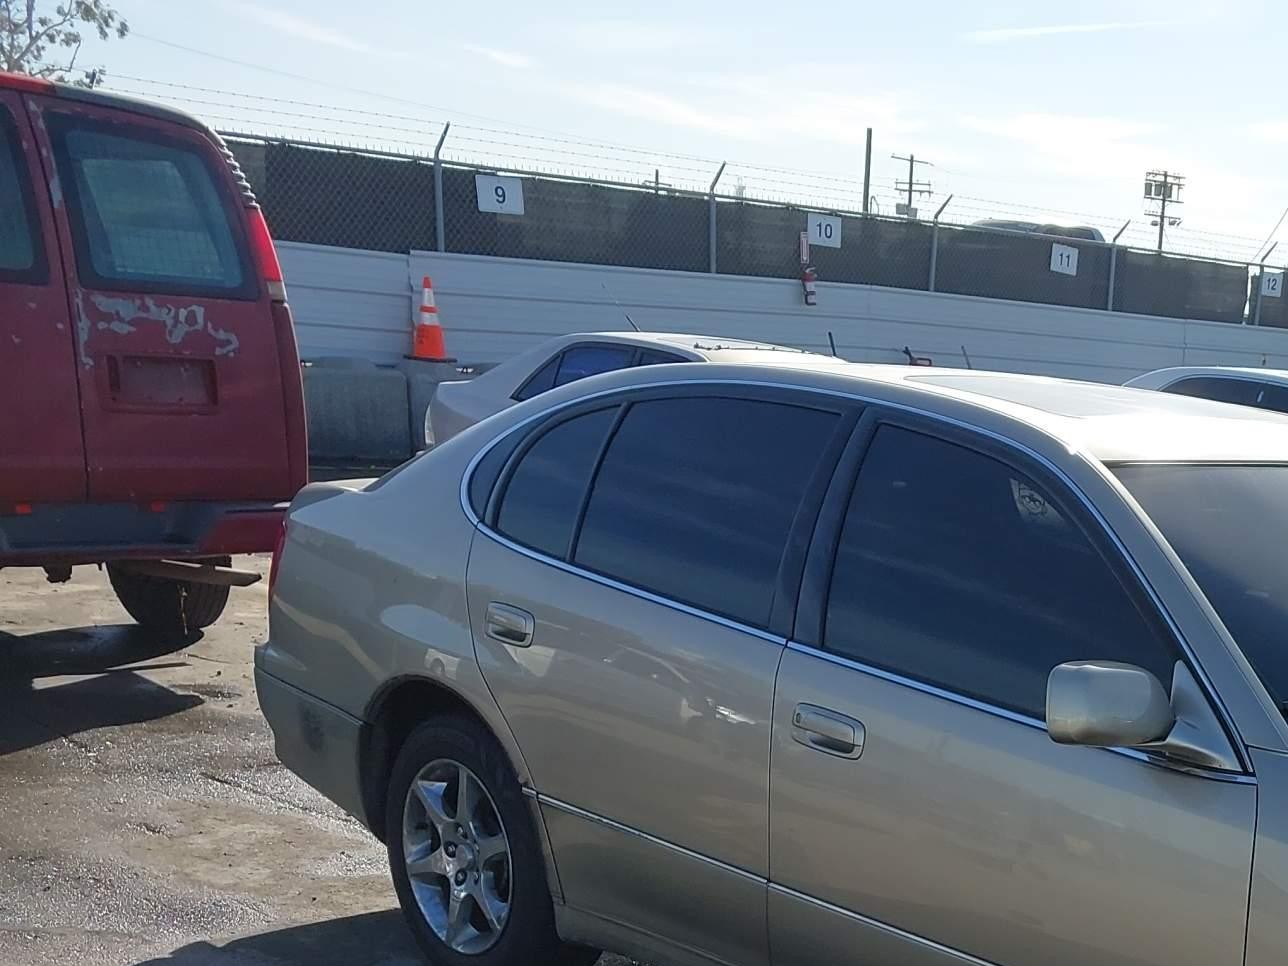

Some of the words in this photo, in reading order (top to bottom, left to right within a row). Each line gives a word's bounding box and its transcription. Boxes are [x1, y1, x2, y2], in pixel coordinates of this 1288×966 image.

[495, 186, 506, 204] 9
[816, 222, 833, 239] 10
[1059, 252, 1070, 268] 11
[1266, 277, 1277, 291] 12
